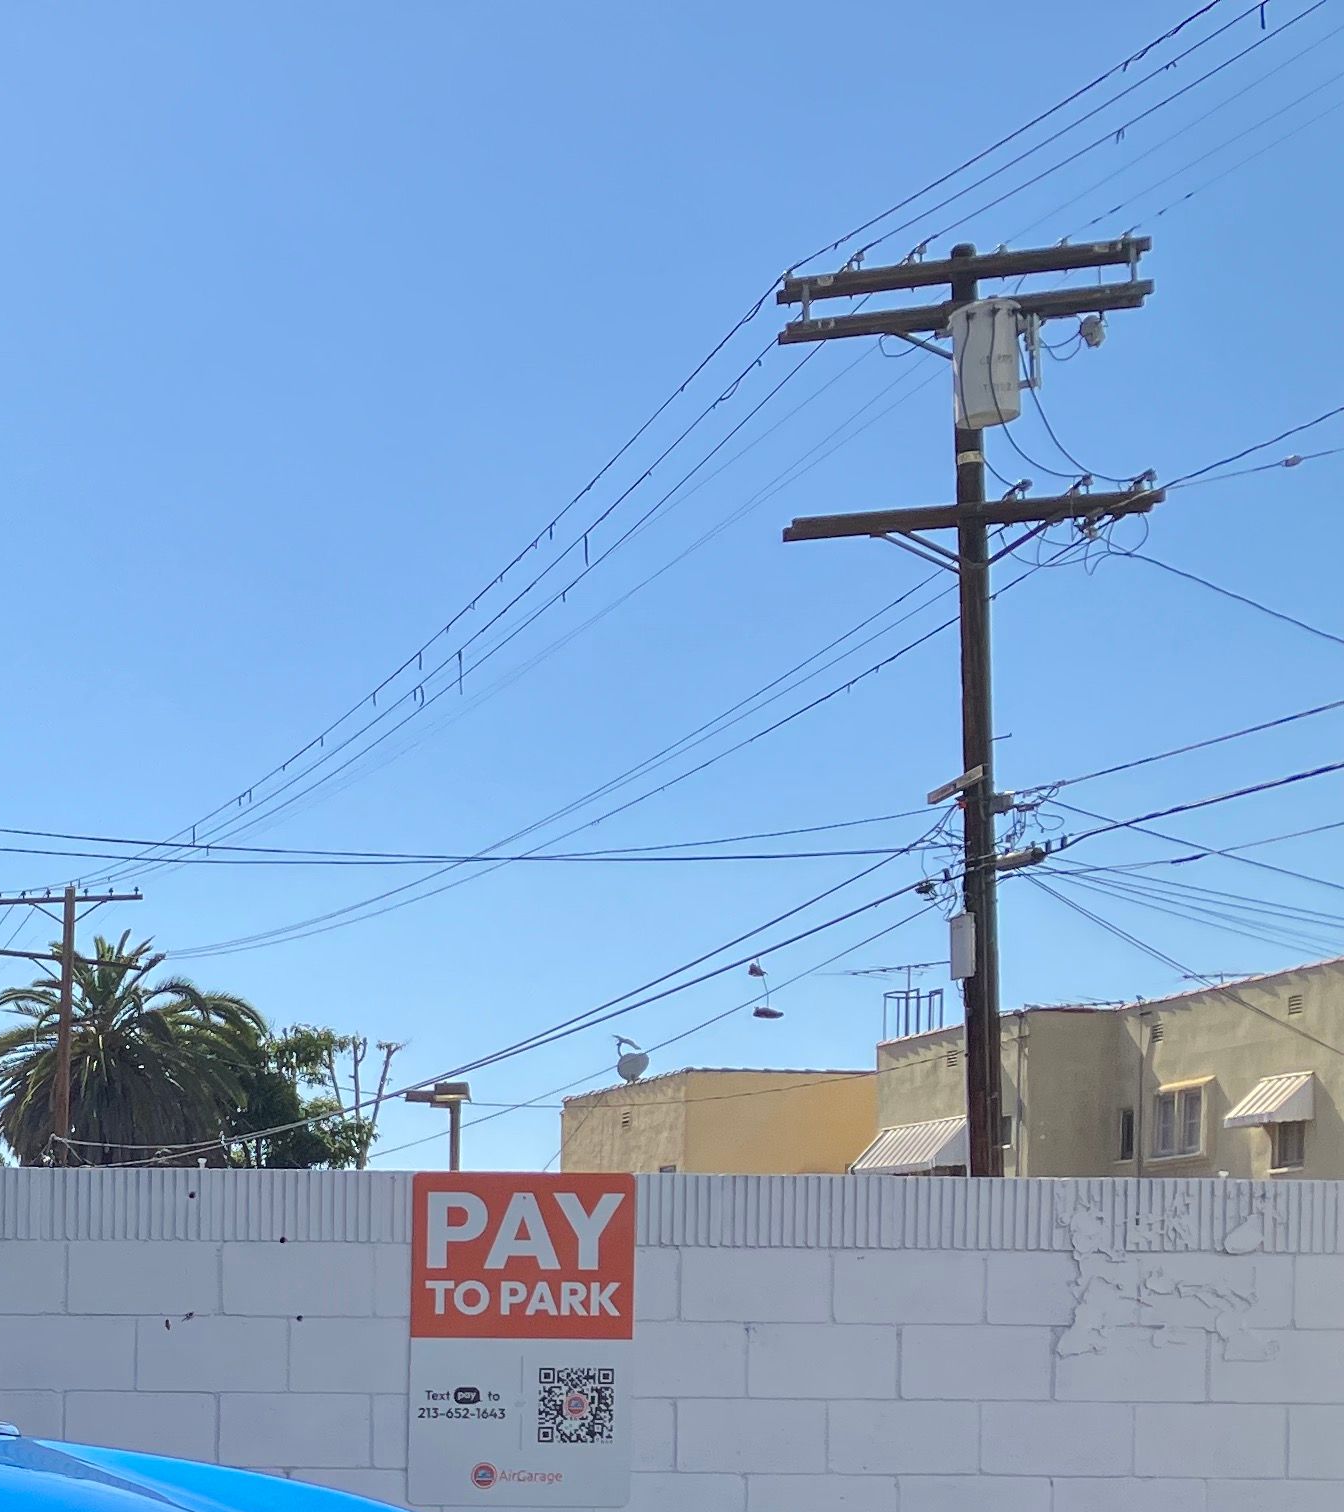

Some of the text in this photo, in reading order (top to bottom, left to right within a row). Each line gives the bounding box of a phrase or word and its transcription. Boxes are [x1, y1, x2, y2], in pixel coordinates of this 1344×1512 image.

[426, 1191, 626, 1271] PAY
[425, 1280, 621, 1317] TO PARK
[425, 1389, 451, 1401] Text
[487, 1390, 501, 1402] to
[417, 1407, 506, 1420] 213-652-1643
[498, 1469, 563, 1485] AirGarage
